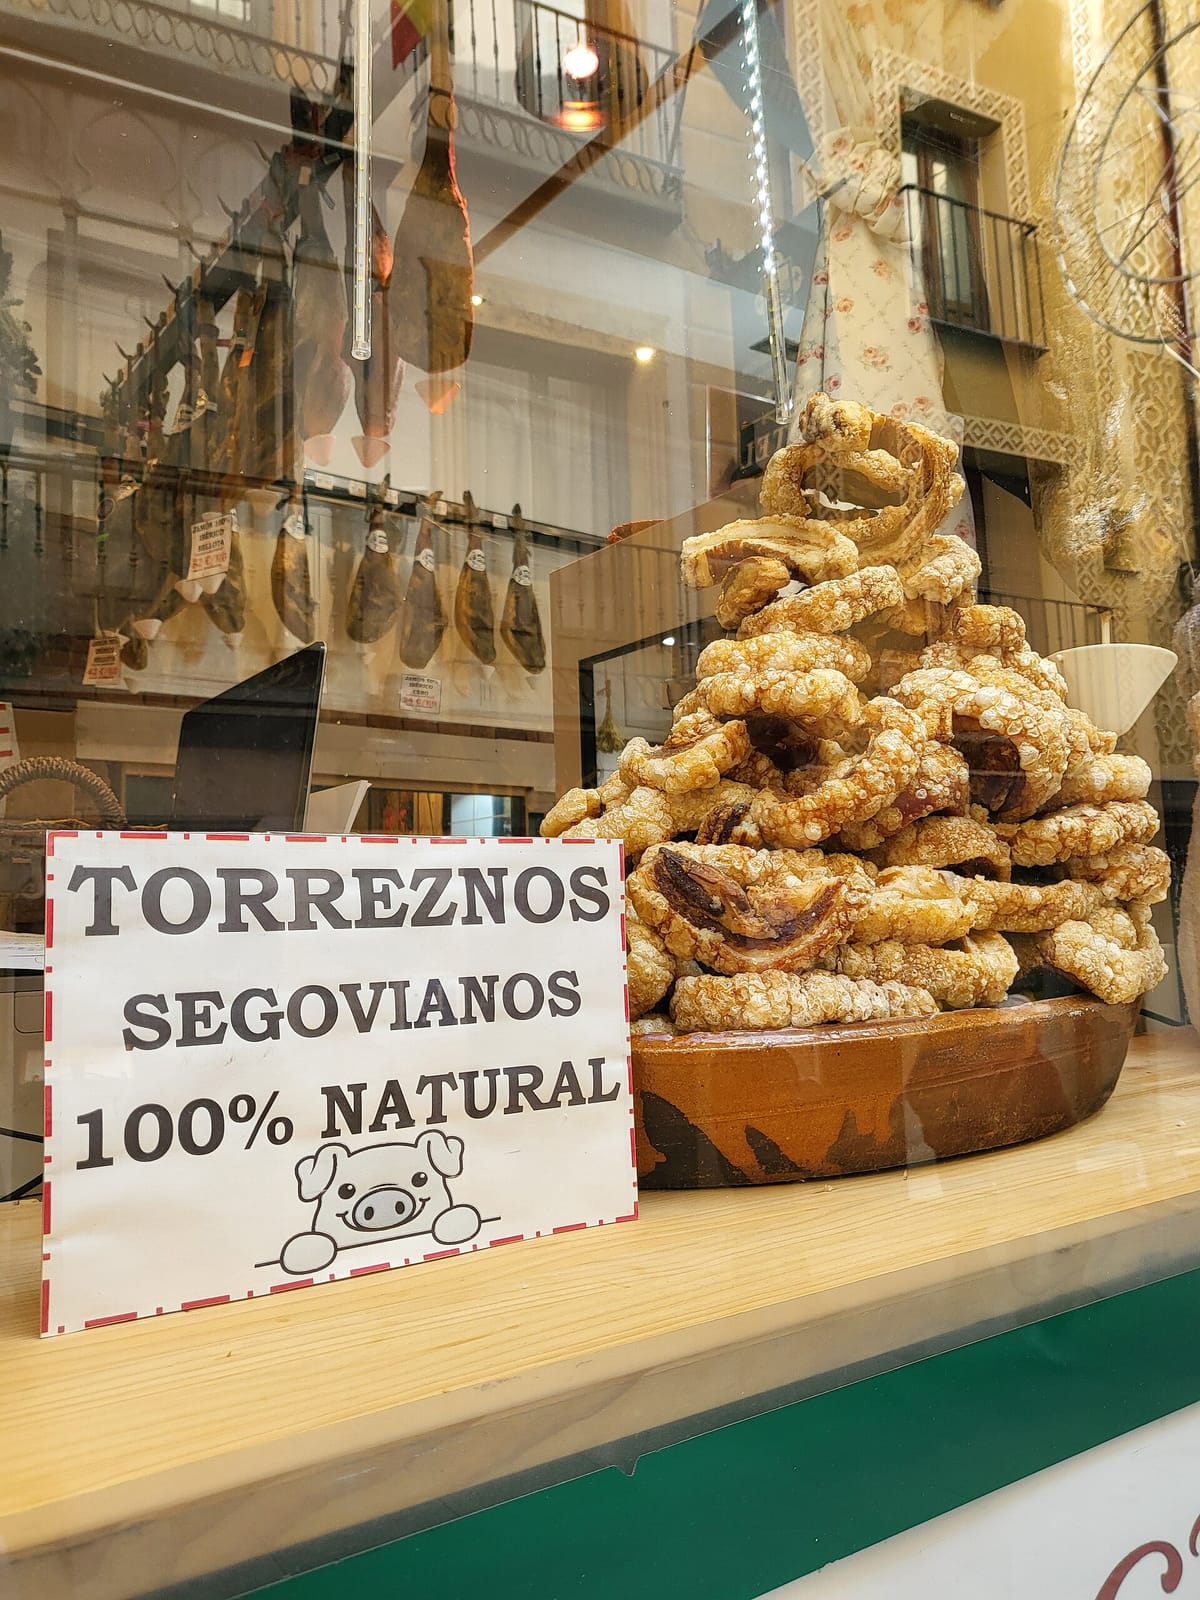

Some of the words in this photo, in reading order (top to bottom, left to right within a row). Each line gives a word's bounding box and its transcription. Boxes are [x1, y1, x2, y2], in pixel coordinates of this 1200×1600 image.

[68, 866, 610, 936] TORREZNOS
[123, 970, 581, 1051] SEGOVIANOS
[77, 1091, 294, 1171] 100%
[321, 1057, 622, 1138] NATURAL
